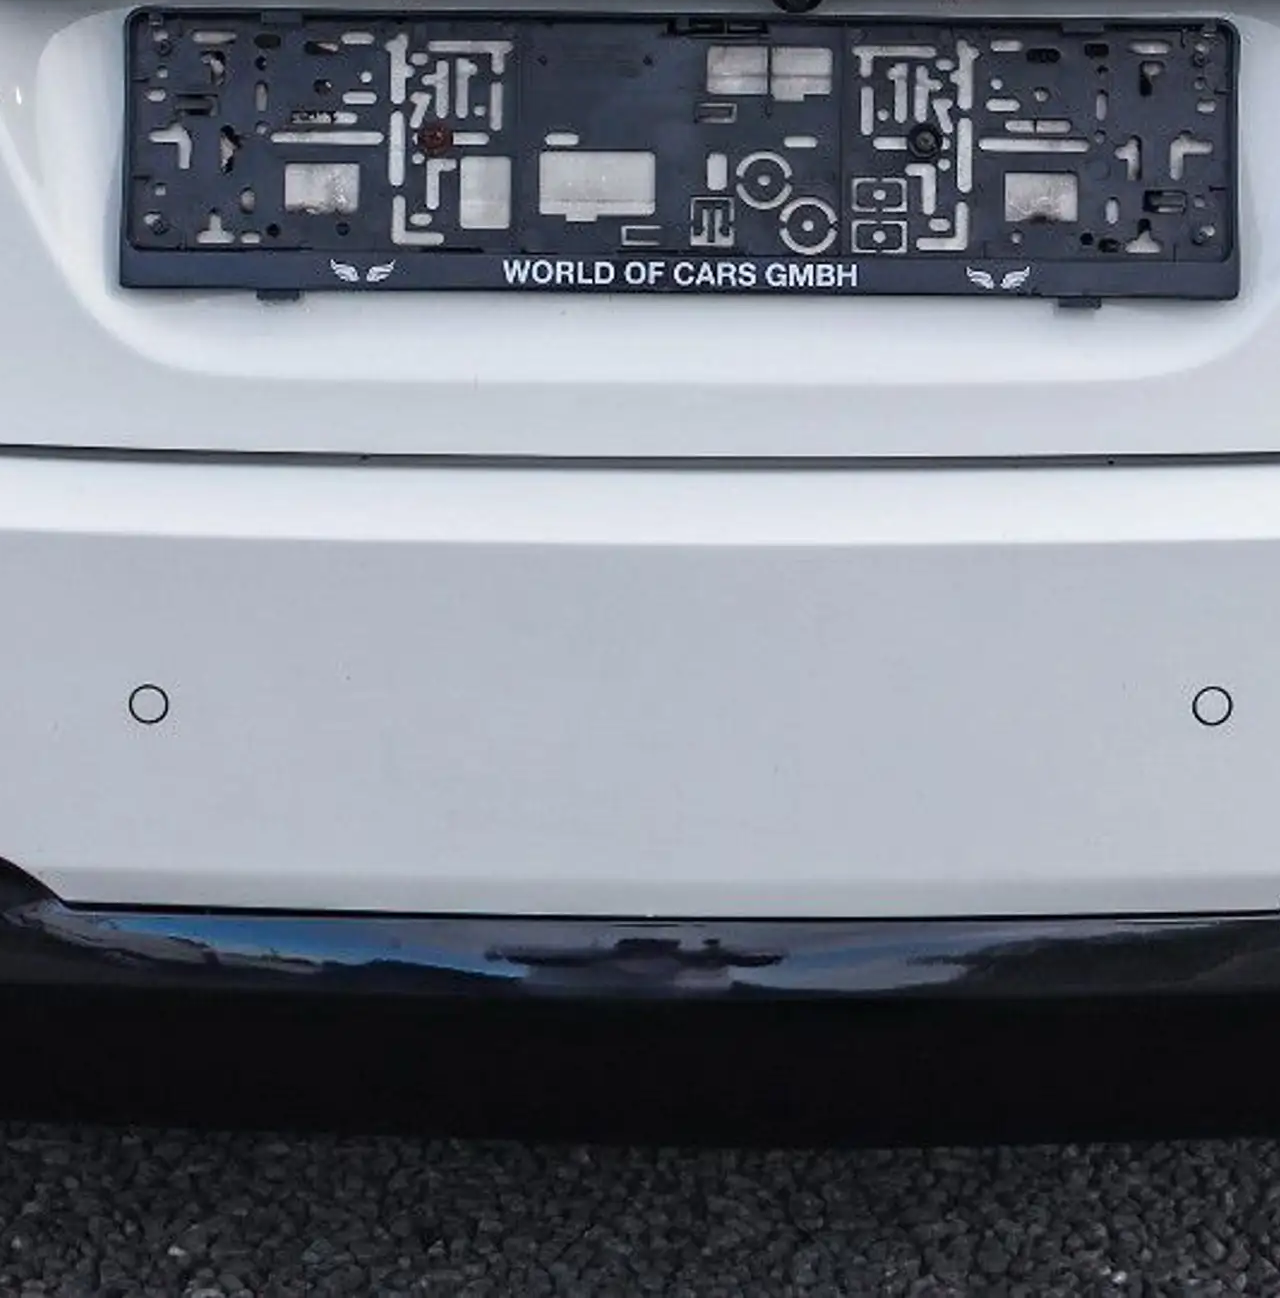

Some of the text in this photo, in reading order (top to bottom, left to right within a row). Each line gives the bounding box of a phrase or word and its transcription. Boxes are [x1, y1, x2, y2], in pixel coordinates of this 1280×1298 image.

[503, 259, 858, 288] WORLD OF CARS GMBH
